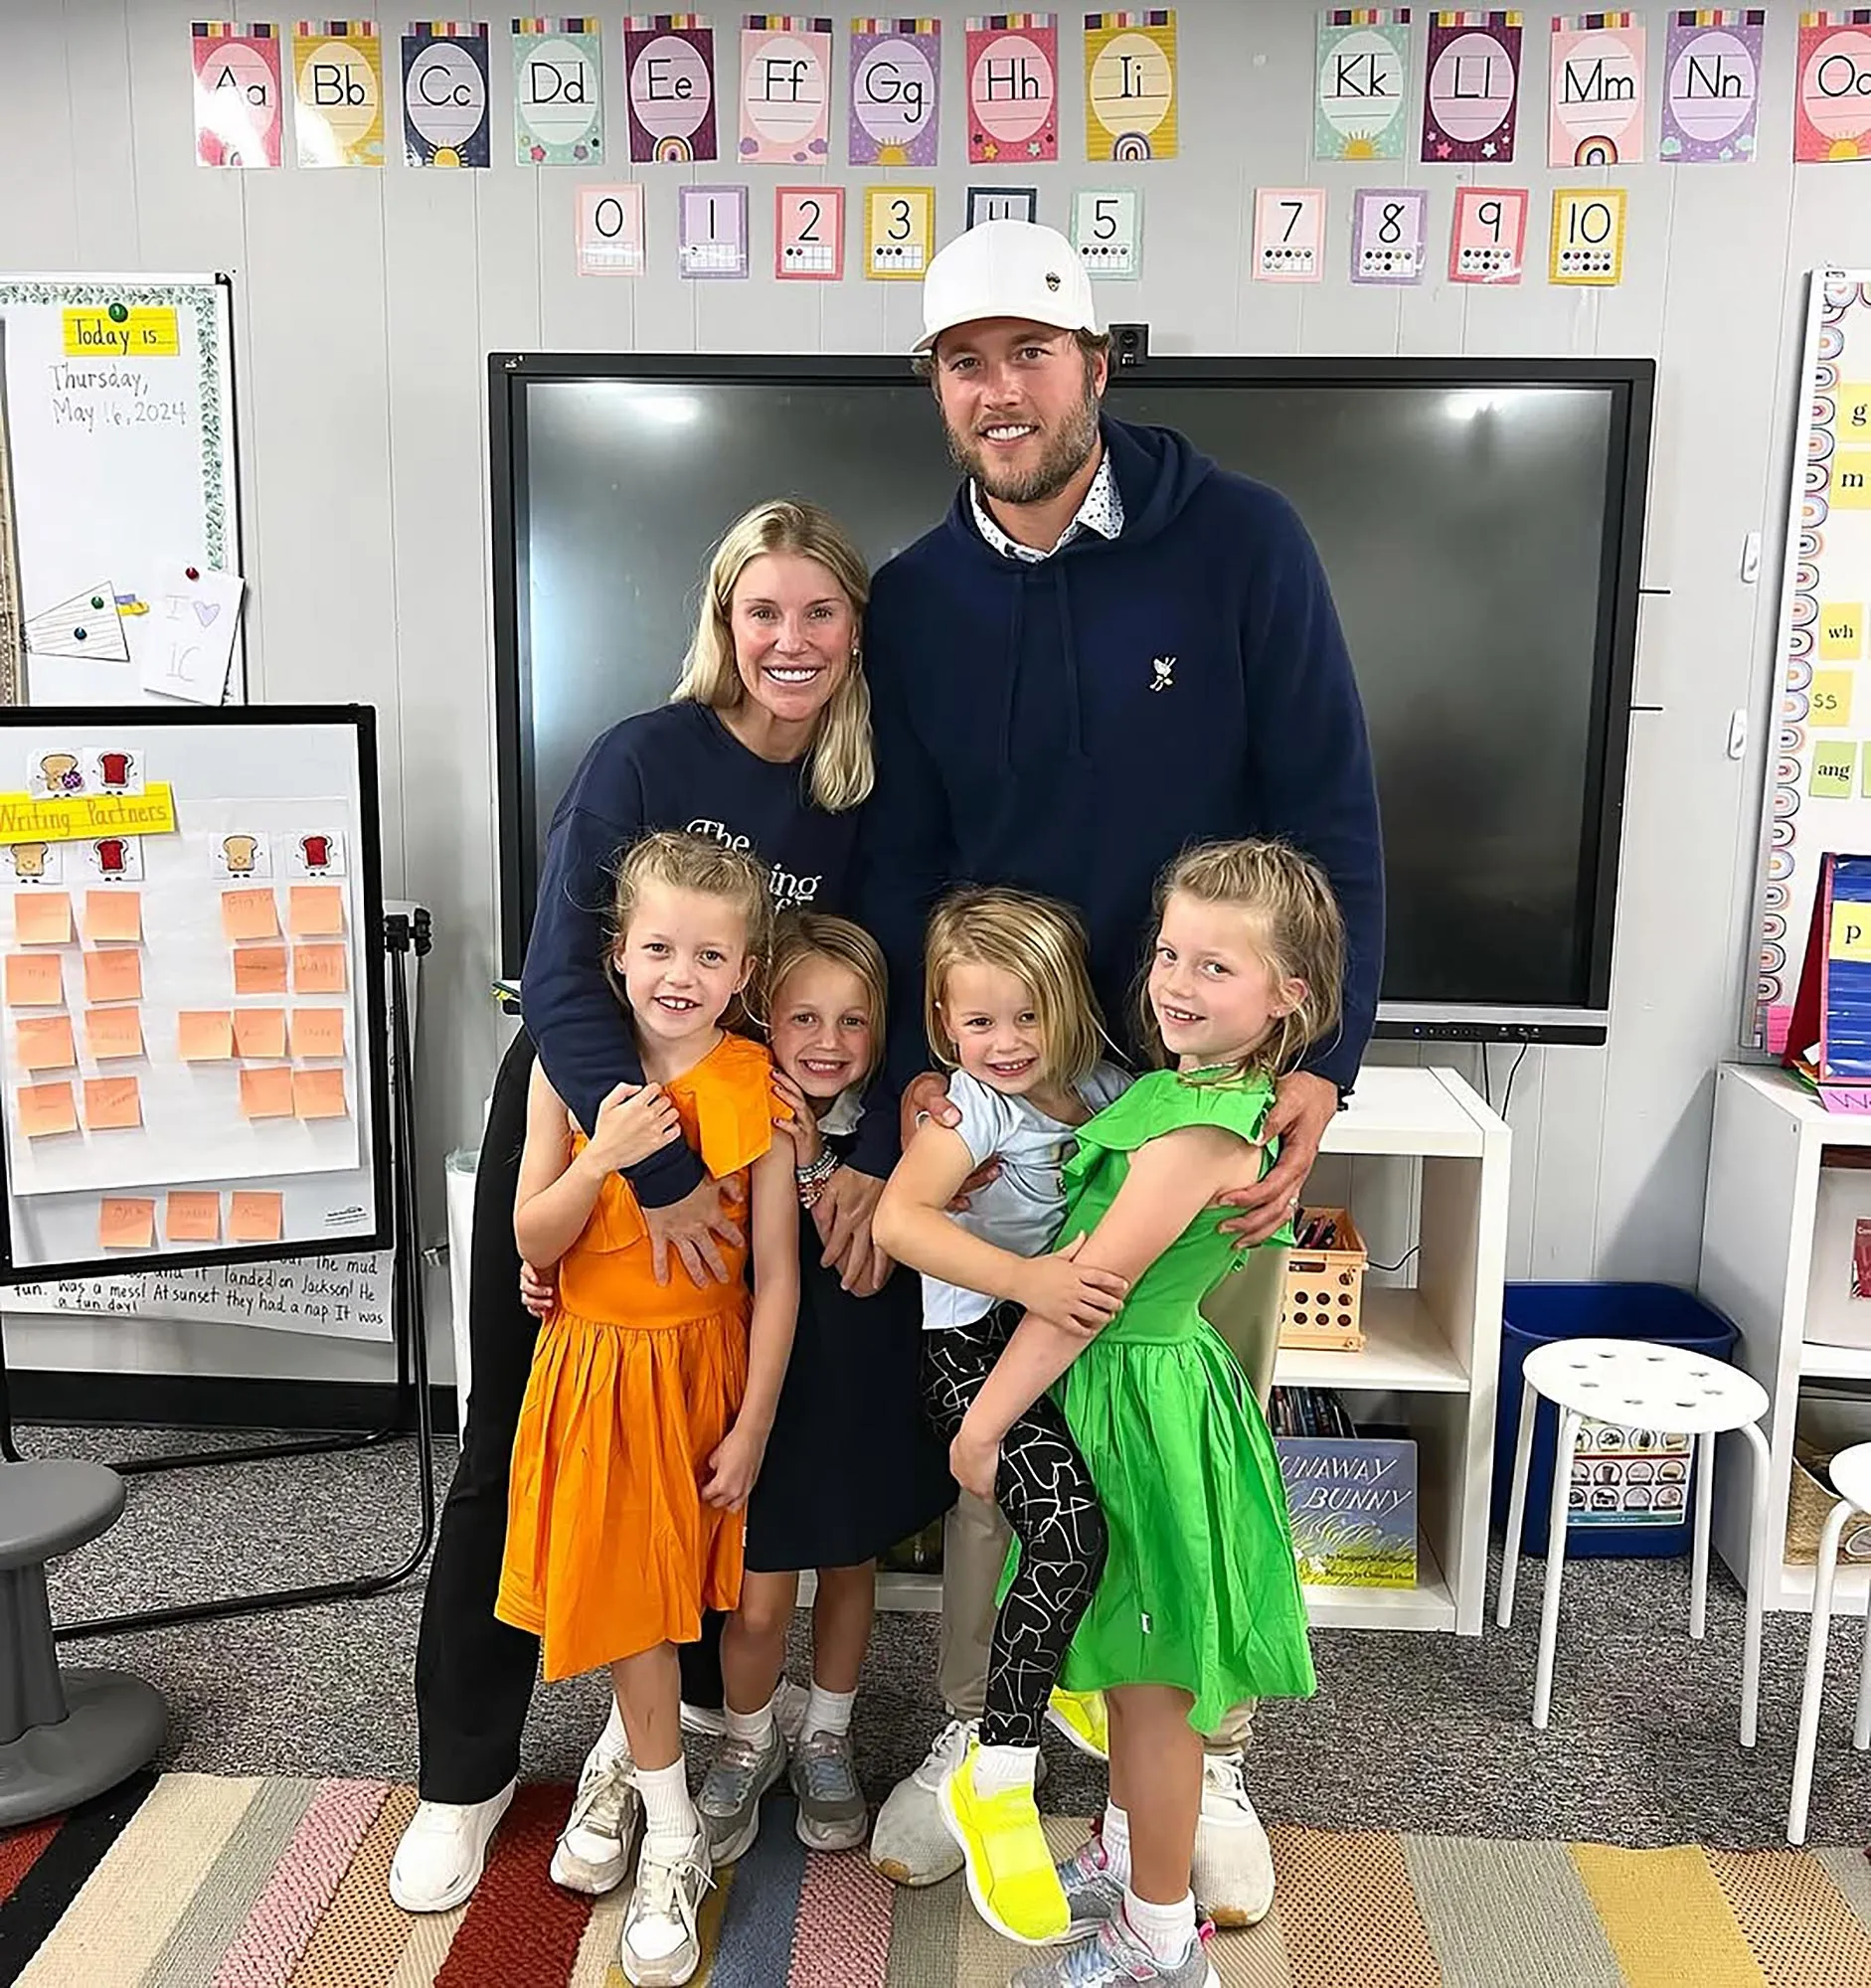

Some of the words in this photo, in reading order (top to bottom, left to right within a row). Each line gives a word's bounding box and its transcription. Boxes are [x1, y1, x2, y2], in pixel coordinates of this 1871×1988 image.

[216, 65, 266, 106] Aa
[314, 65, 365, 105] Bb
[420, 65, 471, 106] Cc
[532, 62, 585, 103] Dd
[647, 58, 692, 100] Ee
[765, 59, 808, 101] Ff
[865, 62, 923, 123] Gg
[987, 58, 1039, 101] Hh
[1120, 56, 1141, 98] Ii
[1336, 54, 1387, 97] Kk
[1454, 57, 1491, 98] Ll
[1565, 59, 1633, 103] Mm
[1687, 55, 1742, 98] Nn
[595, 198, 623, 238] 0
[709, 199, 716, 240] 1
[798, 200, 820, 242] 2
[888, 200, 911, 241] 3
[1094, 200, 1119, 240] 5
[1280, 202, 1303, 243] 7
[1378, 203, 1405, 244] 8
[1478, 202, 1501, 243] 9
[1570, 203, 1611, 244] 10
[73, 318, 129, 356] Today
[142, 329, 157, 344] is
[49, 362, 148, 397] Thursday,
[53, 397, 94, 432] May
[1851, 404, 1868, 426] g
[1841, 473, 1864, 487] m
[1828, 625, 1854, 639] wh
[1817, 764, 1850, 780] ang
[0, 803, 70, 836] Writing
[86, 798, 167, 827] Partners
[686, 819, 751, 852] The
[1845, 925, 1862, 944] p
[224, 1265, 275, 1288] landed
[359, 1284, 376, 1301] He
[347, 1255, 378, 1275] mud
[58, 1296, 67, 1308] a
[77, 1295, 100, 1309] fun
[93, 1283, 102, 1294] a
[109, 1282, 146, 1298] mess!
[154, 1283, 169, 1301] At
[172, 1285, 220, 1304] sunset
[227, 1289, 254, 1316] they
[259, 1292, 286, 1313] had
[290, 1303, 299, 1313] a
[304, 1304, 328, 1323] nap
[358, 1312, 384, 1325] was
[1279, 1455, 1398, 1485] UNAWAY
[1301, 1486, 1412, 1518] BUNNY
